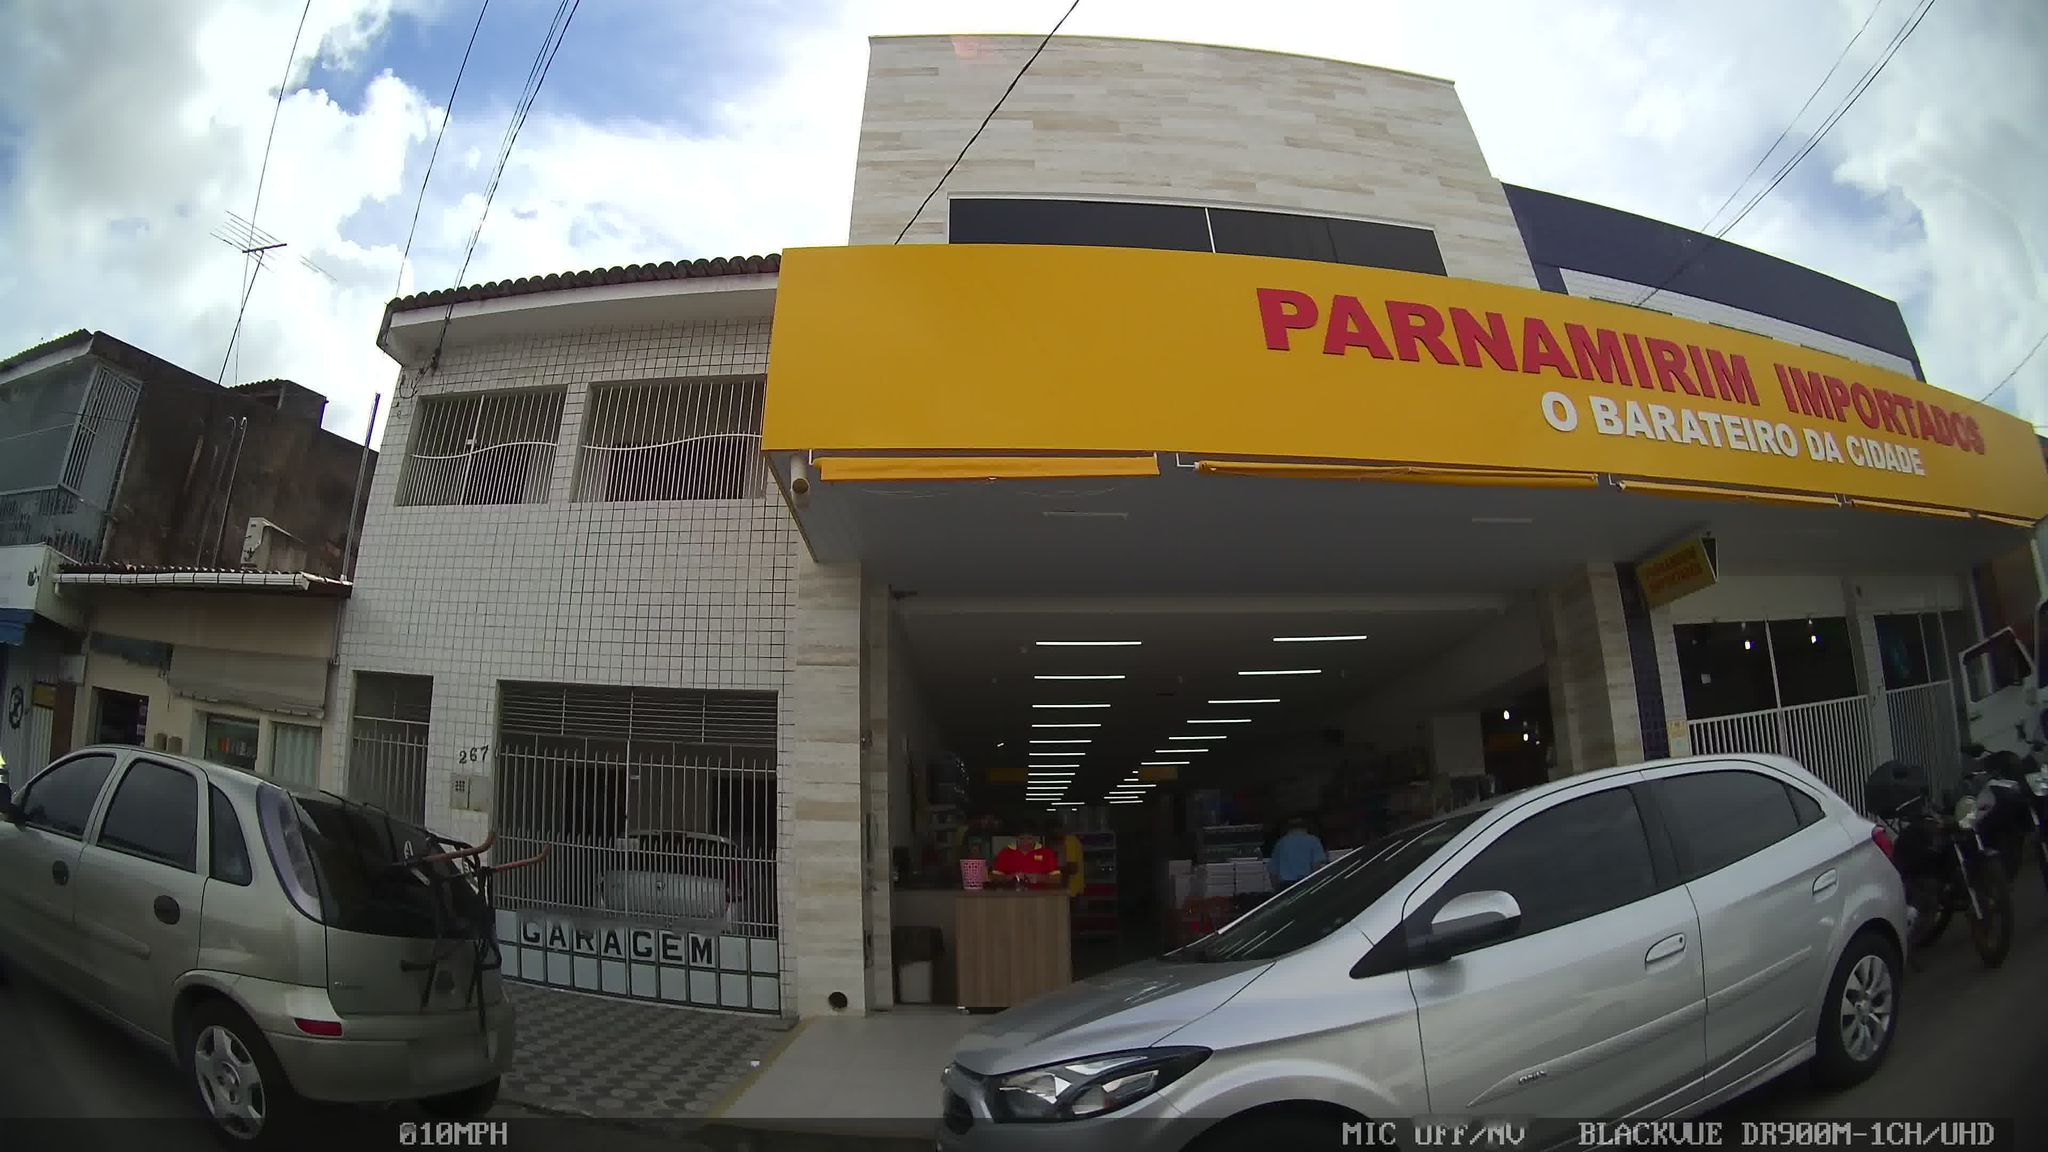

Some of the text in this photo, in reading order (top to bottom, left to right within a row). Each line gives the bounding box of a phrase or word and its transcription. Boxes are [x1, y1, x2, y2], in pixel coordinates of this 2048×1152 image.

[1257, 287, 1986, 456] PARNAMIRIM IMPORTADOS
[1541, 390, 1926, 476] O BARATEIRO DA CIDADE
[459, 744, 489, 765] 267
[521, 919, 713, 965] GARAGEM
